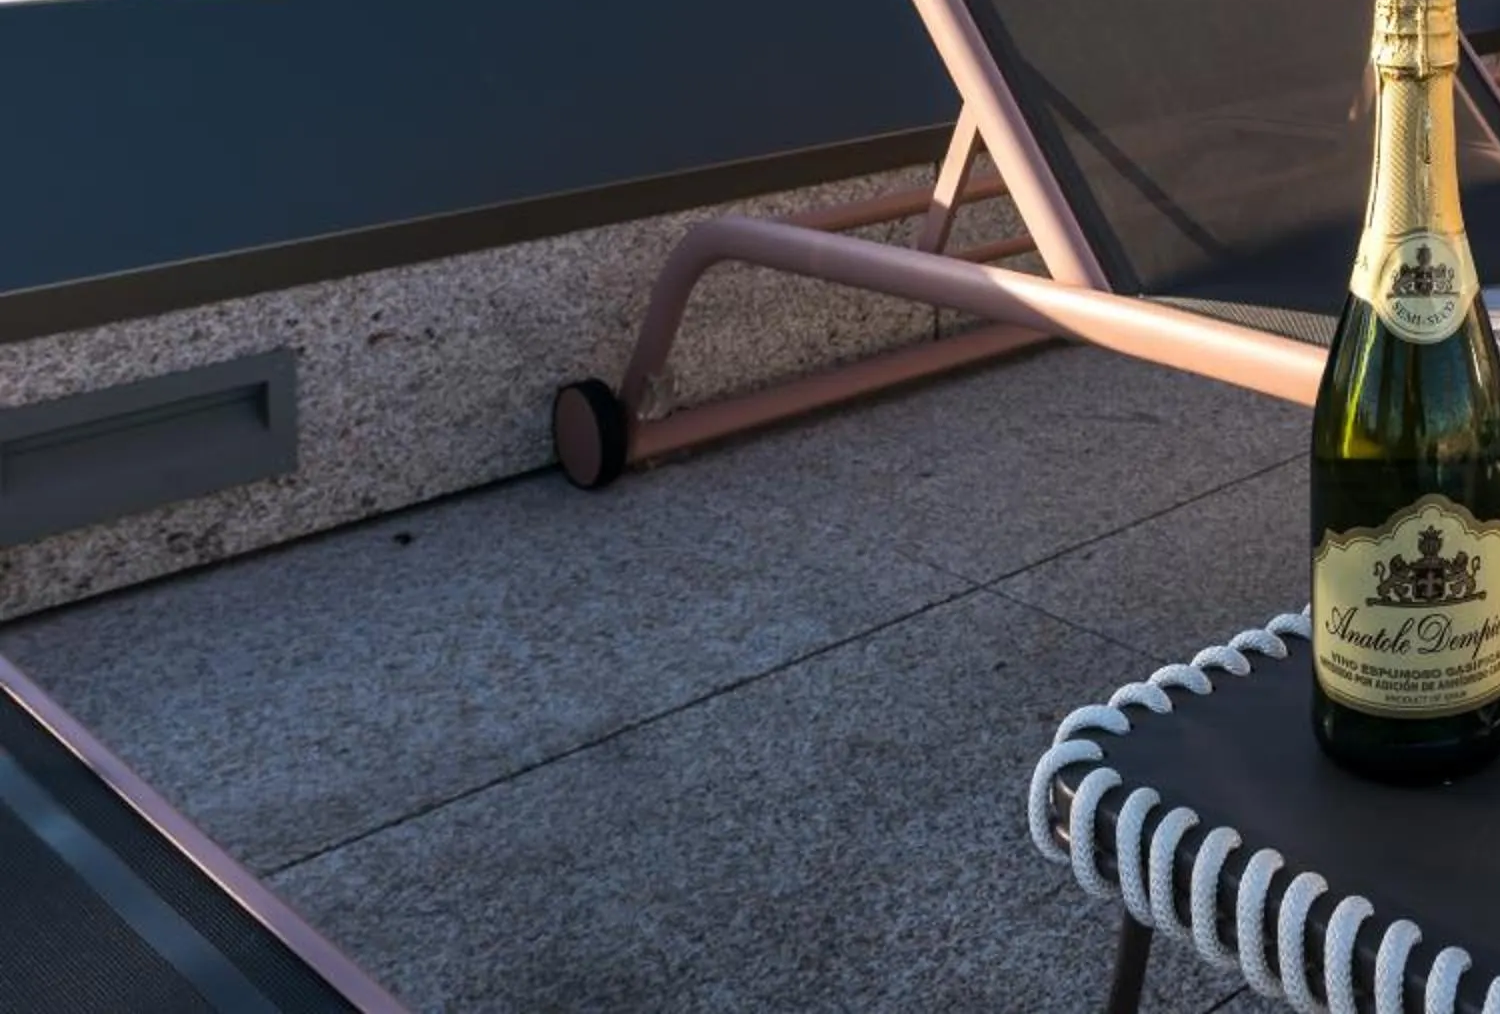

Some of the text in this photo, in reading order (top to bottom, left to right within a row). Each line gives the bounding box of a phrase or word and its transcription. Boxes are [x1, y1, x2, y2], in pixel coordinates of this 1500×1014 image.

[1325, 606, 1412, 655] Anatole
[1331, 650, 1359, 671] VINO
[1361, 663, 1442, 679] ESPUMOSO
[1421, 681, 1437, 692] DE
